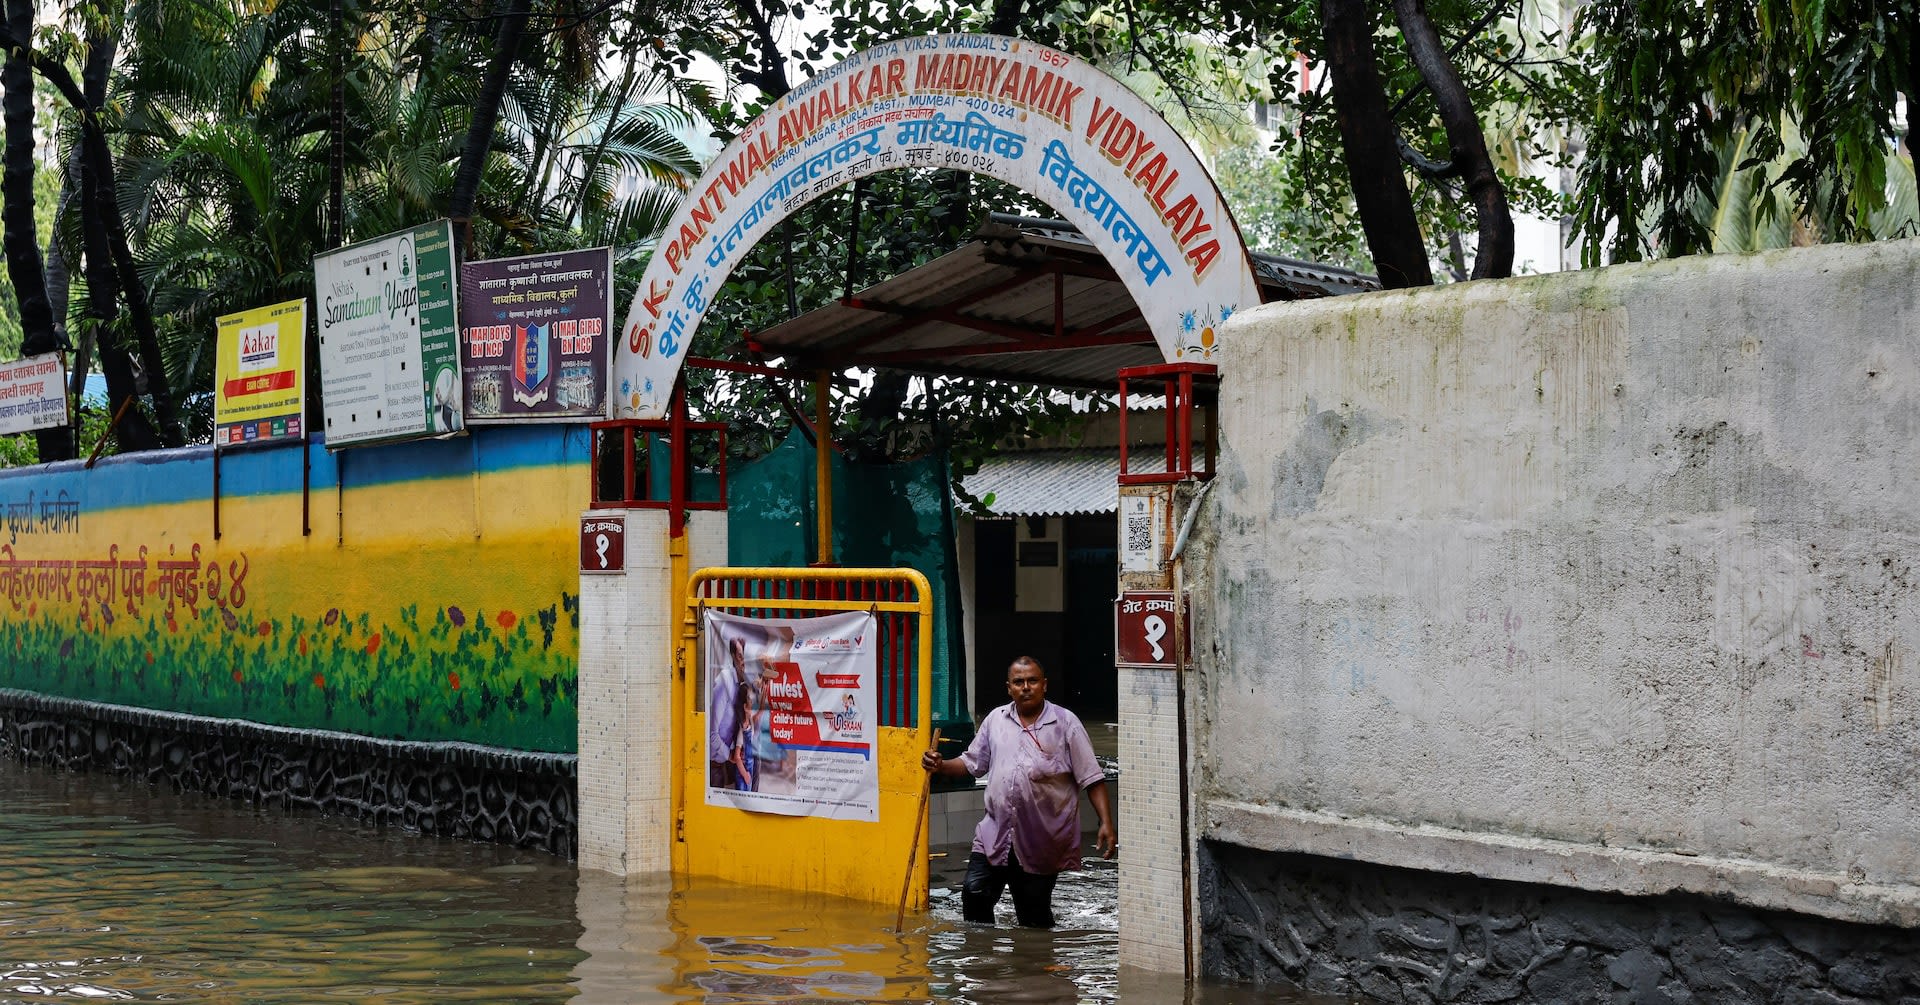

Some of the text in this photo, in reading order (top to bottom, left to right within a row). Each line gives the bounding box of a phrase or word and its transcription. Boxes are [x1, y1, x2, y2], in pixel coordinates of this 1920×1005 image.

[1039, 49, 1070, 69] 1967
[788, 57, 861, 105] MAHARASHTRA
[867, 43, 898, 61] VIDYA
[905, 36, 938, 52] VIKAS
[771, 145, 800, 171] NEHRU
[909, 95, 955, 108] MUMBAI
[905, 142, 935, 167] मुंबई
[665, 58, 907, 275] PANTWALAWALKAR
[914, 54, 1084, 132] MADHYAMIK
[1085, 96, 1224, 285] VIDYALAYA
[705, 126, 886, 268] पंतवालावलकर
[897, 111, 1027, 160] माध्यमिक
[331, 279, 355, 298] Nisha's
[478, 277, 507, 291] शांताराम
[509, 273, 538, 291] कृष्णाजी
[540, 269, 593, 284] पंतवालावलकर
[324, 292, 382, 329] Samatvam
[384, 278, 417, 320] Yoga
[492, 292, 525, 305] माध्यमिक
[463, 324, 511, 343] 1 MAH BOYS
[552, 317, 602, 338] 1 MAH GIRLS
[243, 330, 275, 354] Aakar
[471, 341, 483, 358] BN
[485, 340, 503, 357] NCC
[561, 336, 592, 354] BN NCC
[526, 354, 537, 364] NCC
[40, 488, 80, 535] संचालित
[596, 533, 610, 569] १
[37, 560, 74, 603] नगर
[120, 544, 148, 620] पूर्व
[1122, 599, 1143, 614] गेट
[1144, 614, 1167, 662] १
[770, 671, 803, 699] Invest
[771, 699, 793, 712] in your
[773, 712, 814, 726] child's future
[773, 728, 794, 741] today!
